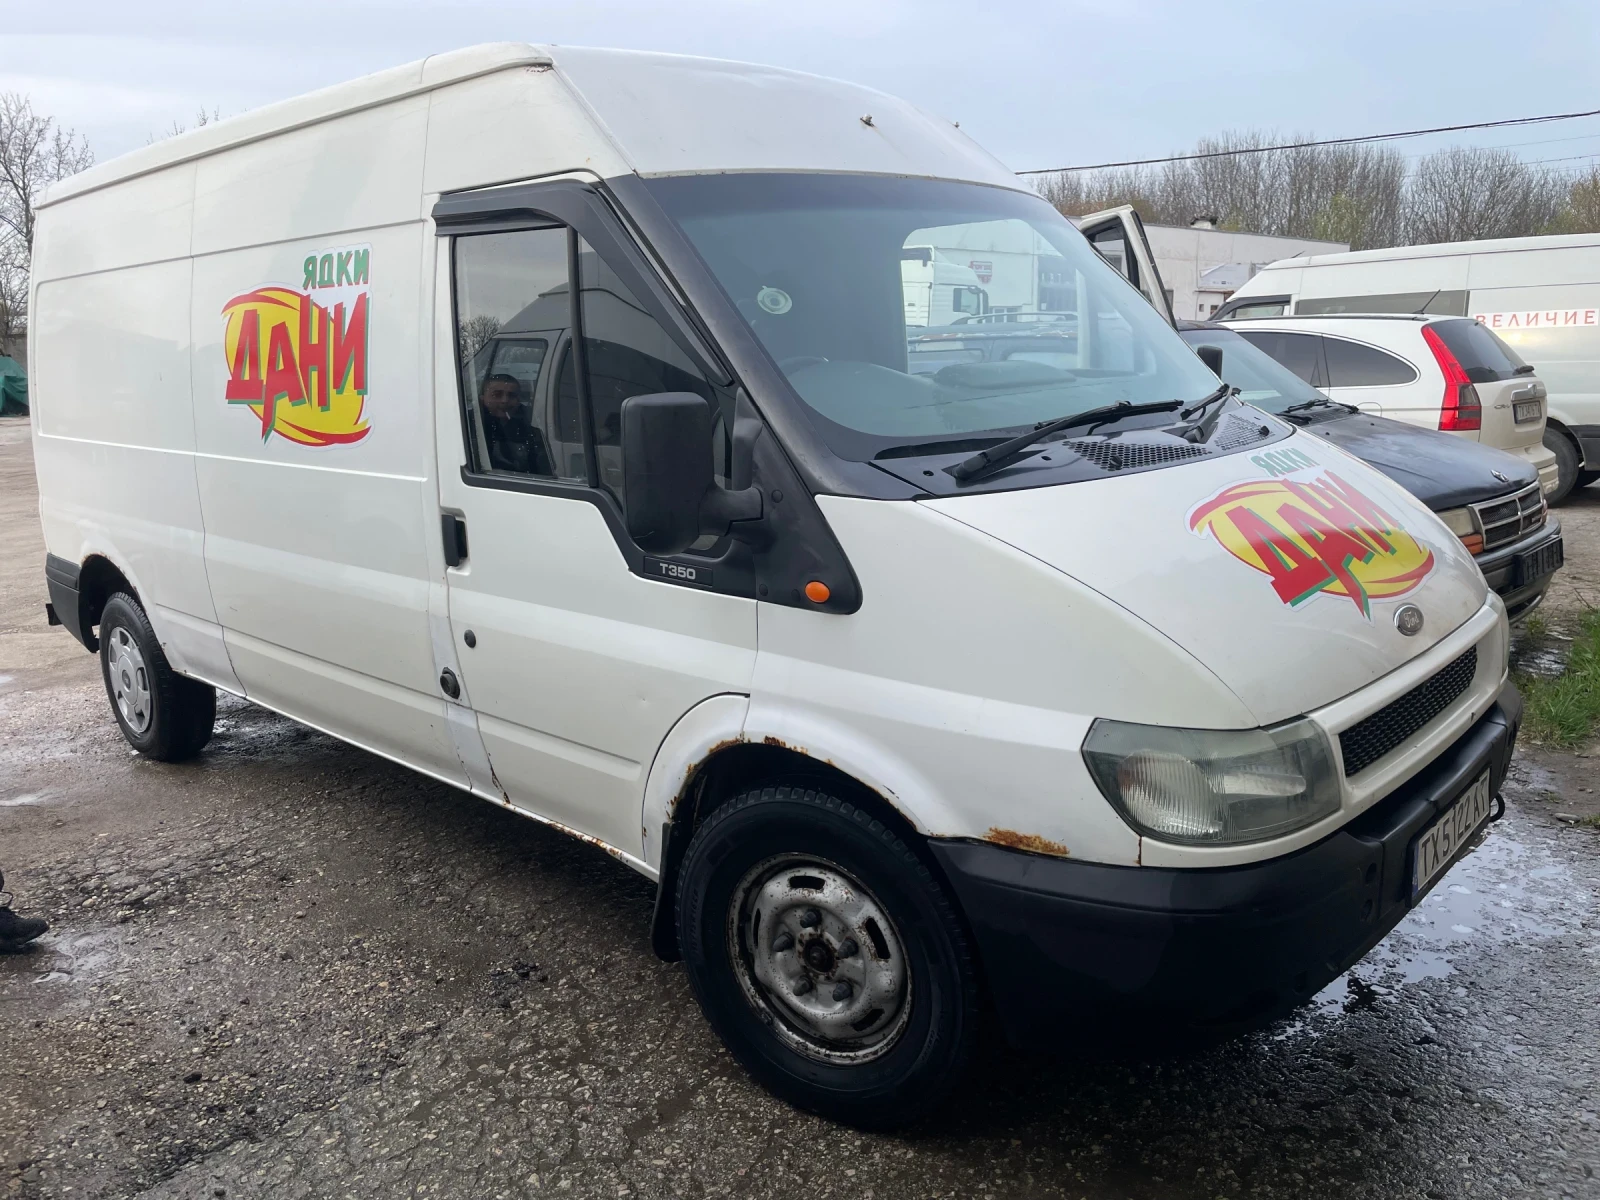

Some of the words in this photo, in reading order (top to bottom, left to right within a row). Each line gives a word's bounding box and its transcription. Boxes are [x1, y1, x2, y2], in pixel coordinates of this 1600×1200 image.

[302, 248, 369, 290] ЯДКИ
[1475, 310, 1596, 329] ВЕЛИЧИЕ
[225, 291, 370, 445] ДАНИ
[1250, 447, 1320, 477] ЯДКИ
[1225, 469, 1406, 622] ДАНИ
[660, 563, 696, 580] T350
